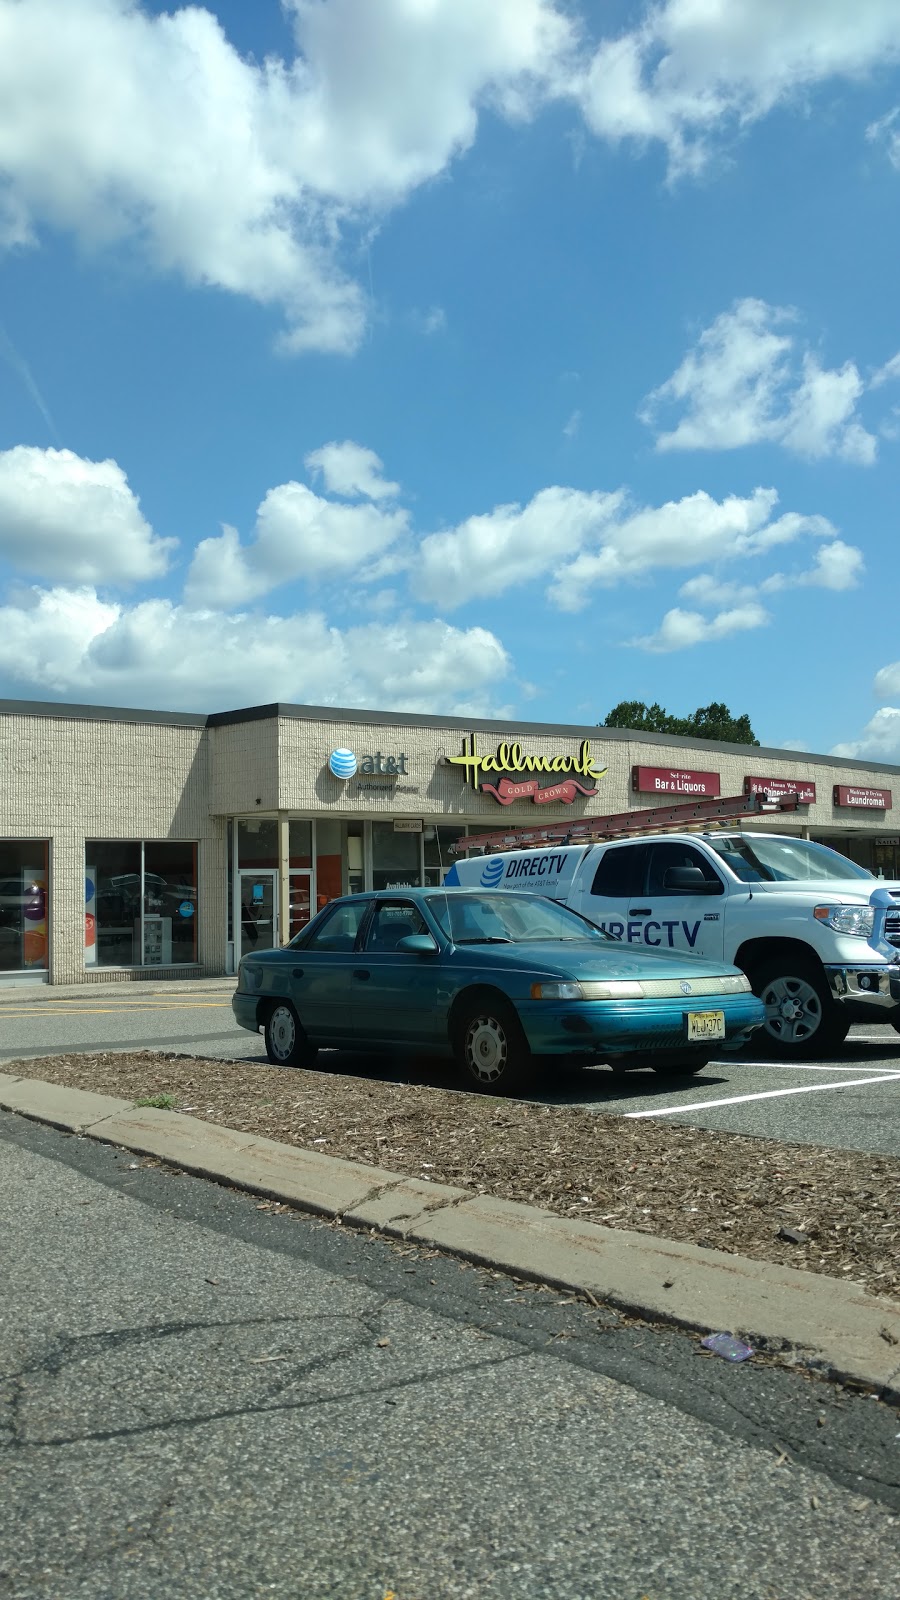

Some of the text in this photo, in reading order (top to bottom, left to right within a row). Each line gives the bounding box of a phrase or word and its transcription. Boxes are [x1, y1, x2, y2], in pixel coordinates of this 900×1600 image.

[360, 751, 409, 776] at&t
[445, 733, 608, 790] Hallmark
[357, 783, 420, 793] Authorized Retailer
[507, 785, 534, 796] GOLD
[654, 777, 670, 790] Bar
[677, 780, 706, 793] Liquors
[537, 787, 570, 802] CROWN
[847, 795, 885, 807] Laundromat
[505, 854, 568, 879] DIRECTV
[513, 882, 522, 890] part
